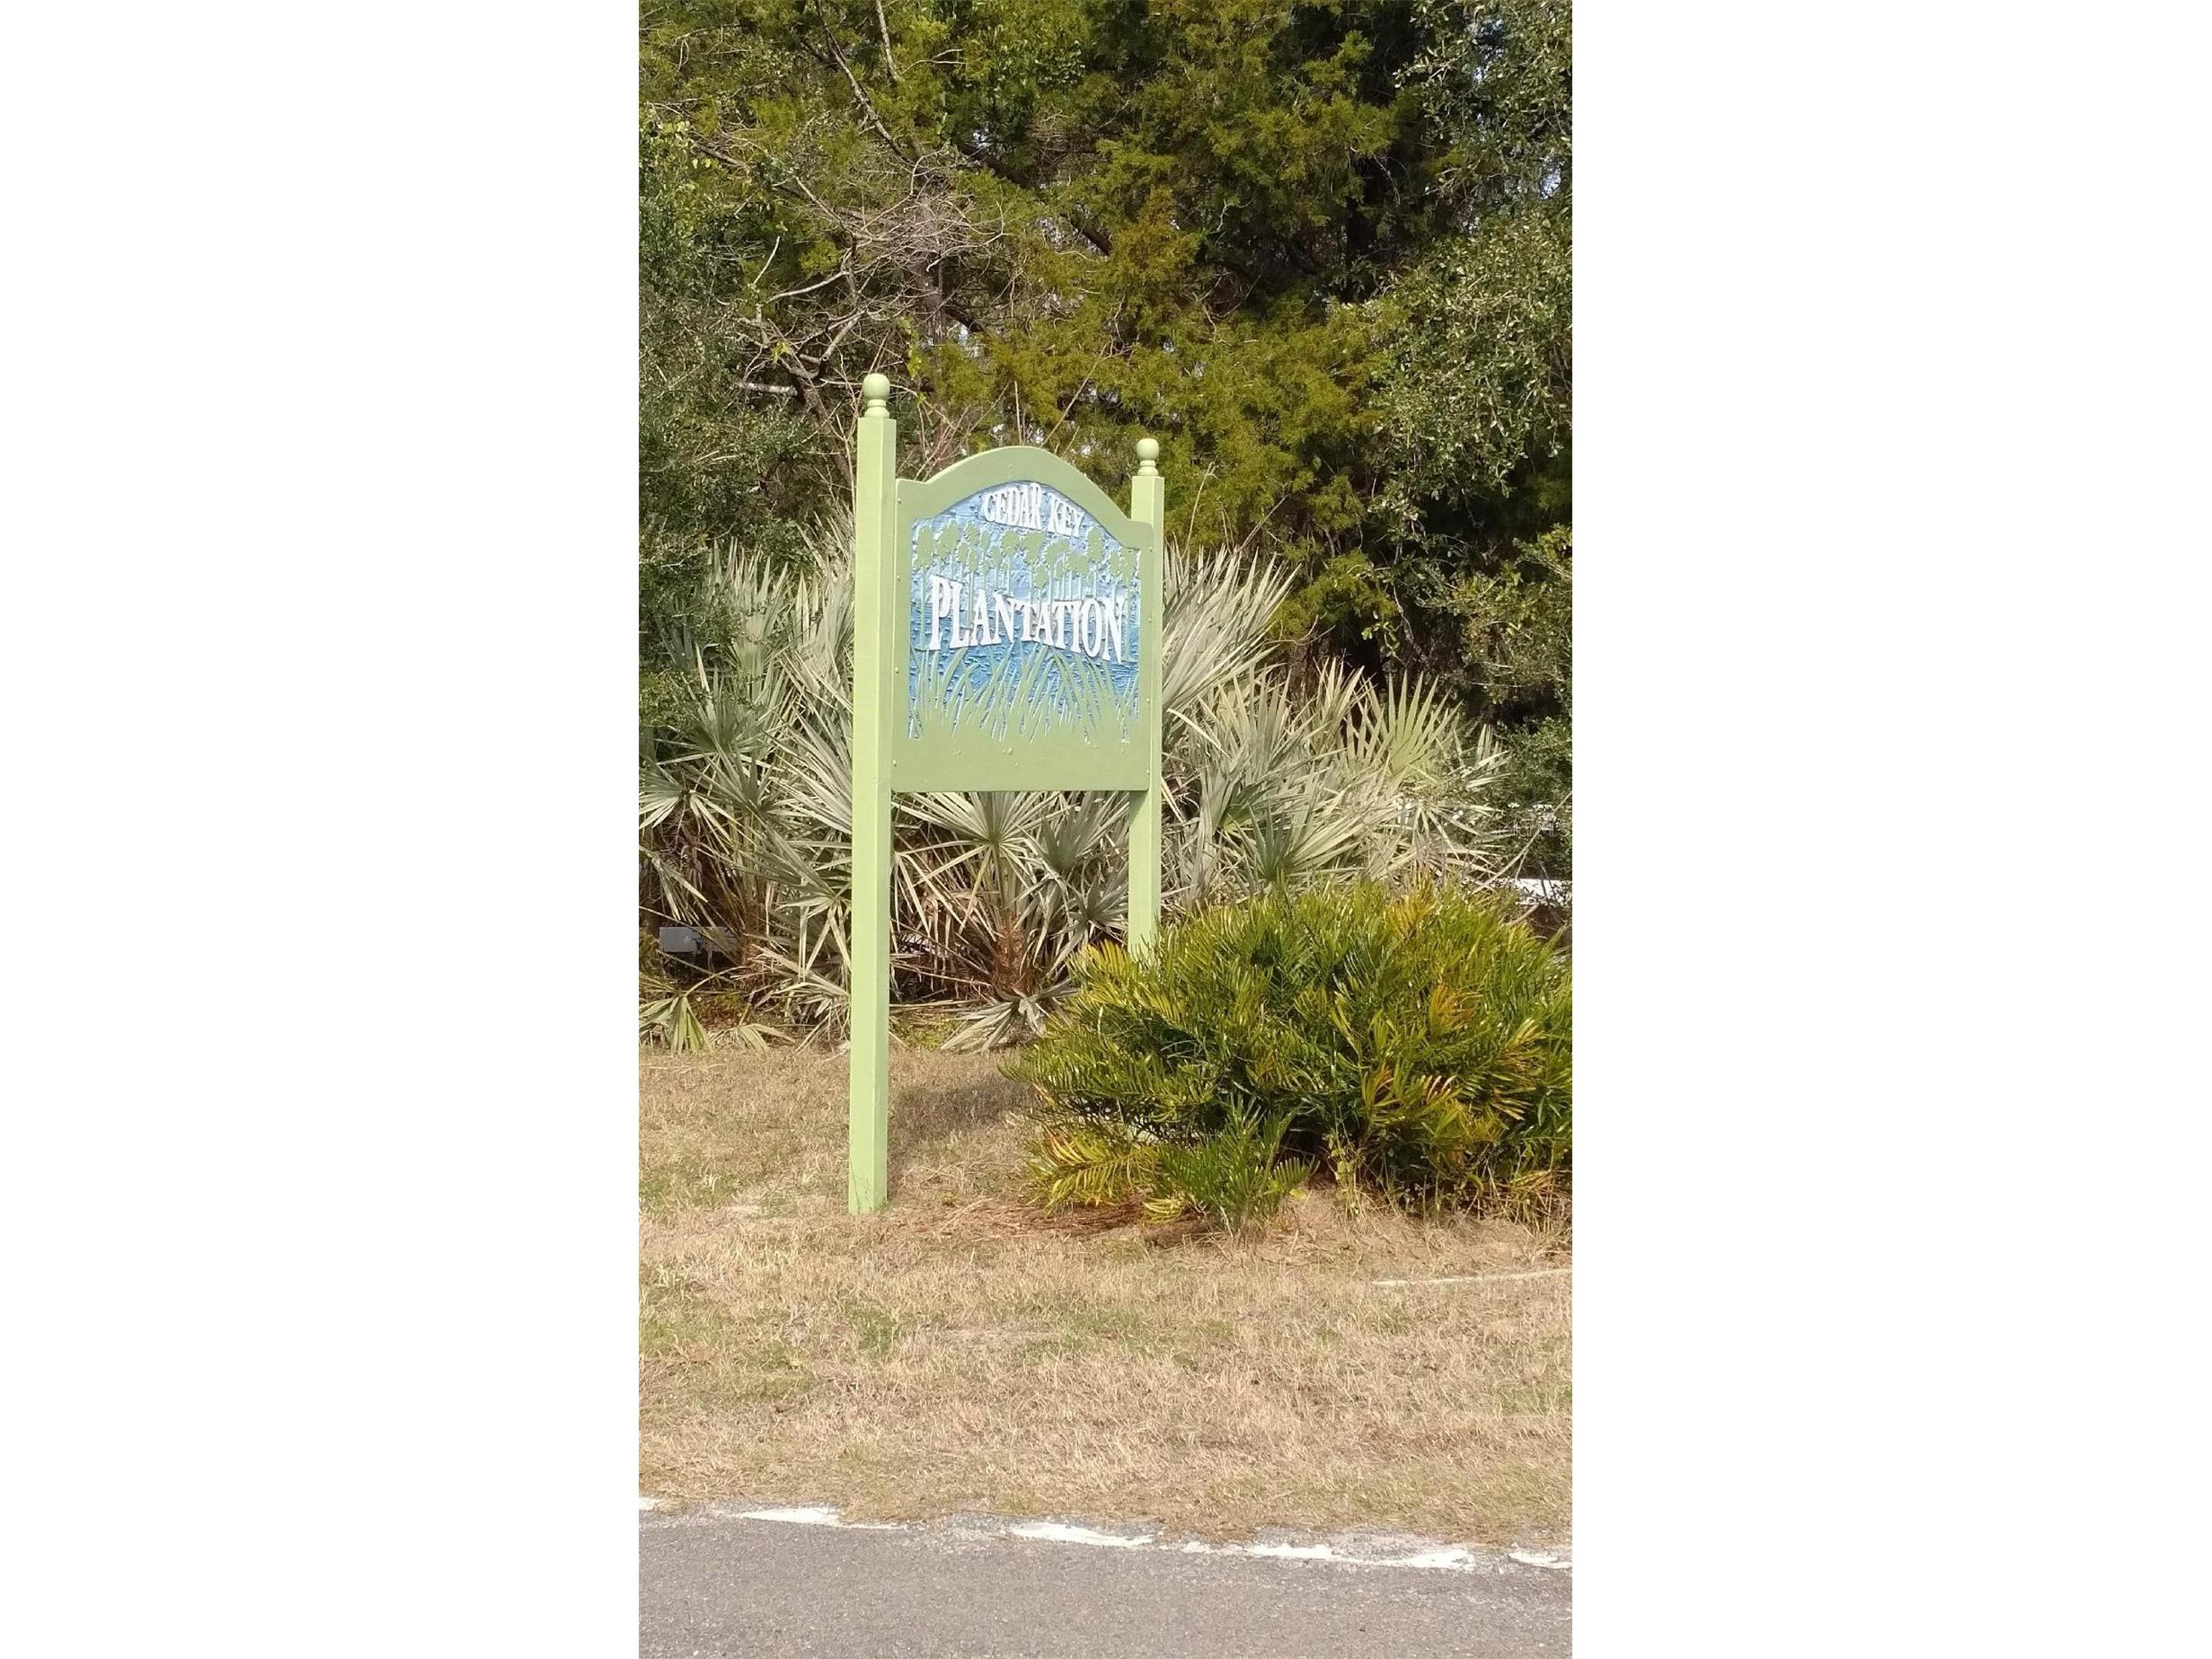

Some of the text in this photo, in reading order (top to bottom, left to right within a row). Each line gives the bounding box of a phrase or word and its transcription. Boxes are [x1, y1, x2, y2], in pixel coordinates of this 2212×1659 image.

[982, 482, 1085, 538] CEDAR KEY
[929, 574, 1125, 664] PLANTATION
